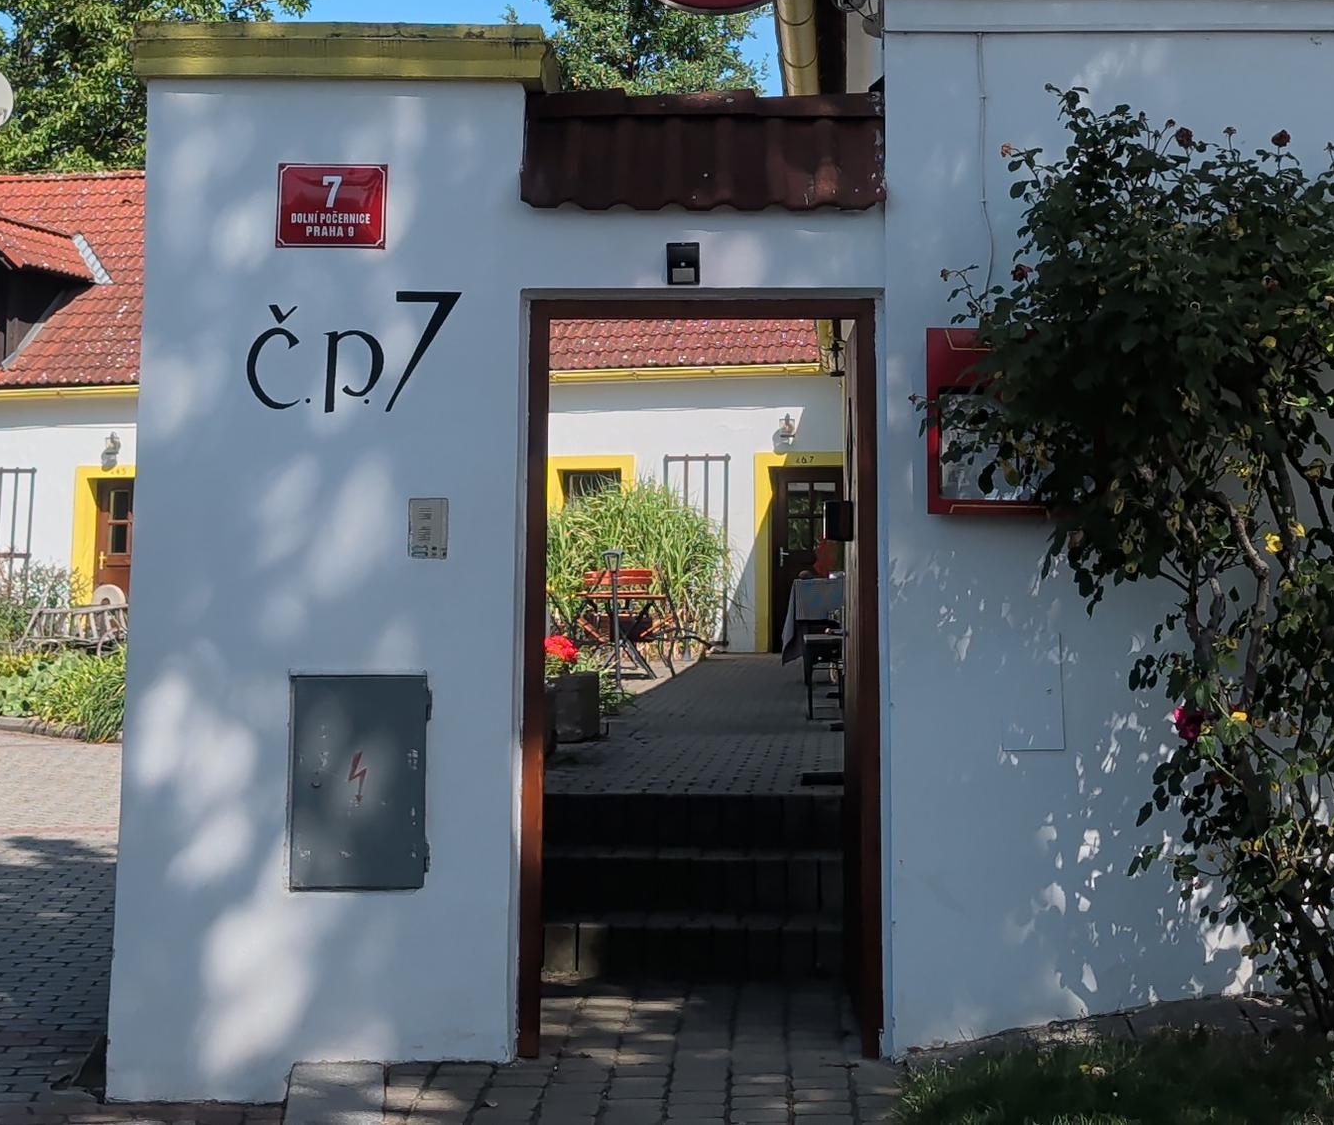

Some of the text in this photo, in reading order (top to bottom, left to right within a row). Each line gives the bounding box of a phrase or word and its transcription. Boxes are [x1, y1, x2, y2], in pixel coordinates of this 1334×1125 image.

[322, 176, 342, 208] 7
[291, 211, 371, 224] DOLNÍ POČERNICE
[306, 226, 355, 237] PRAHA 9
